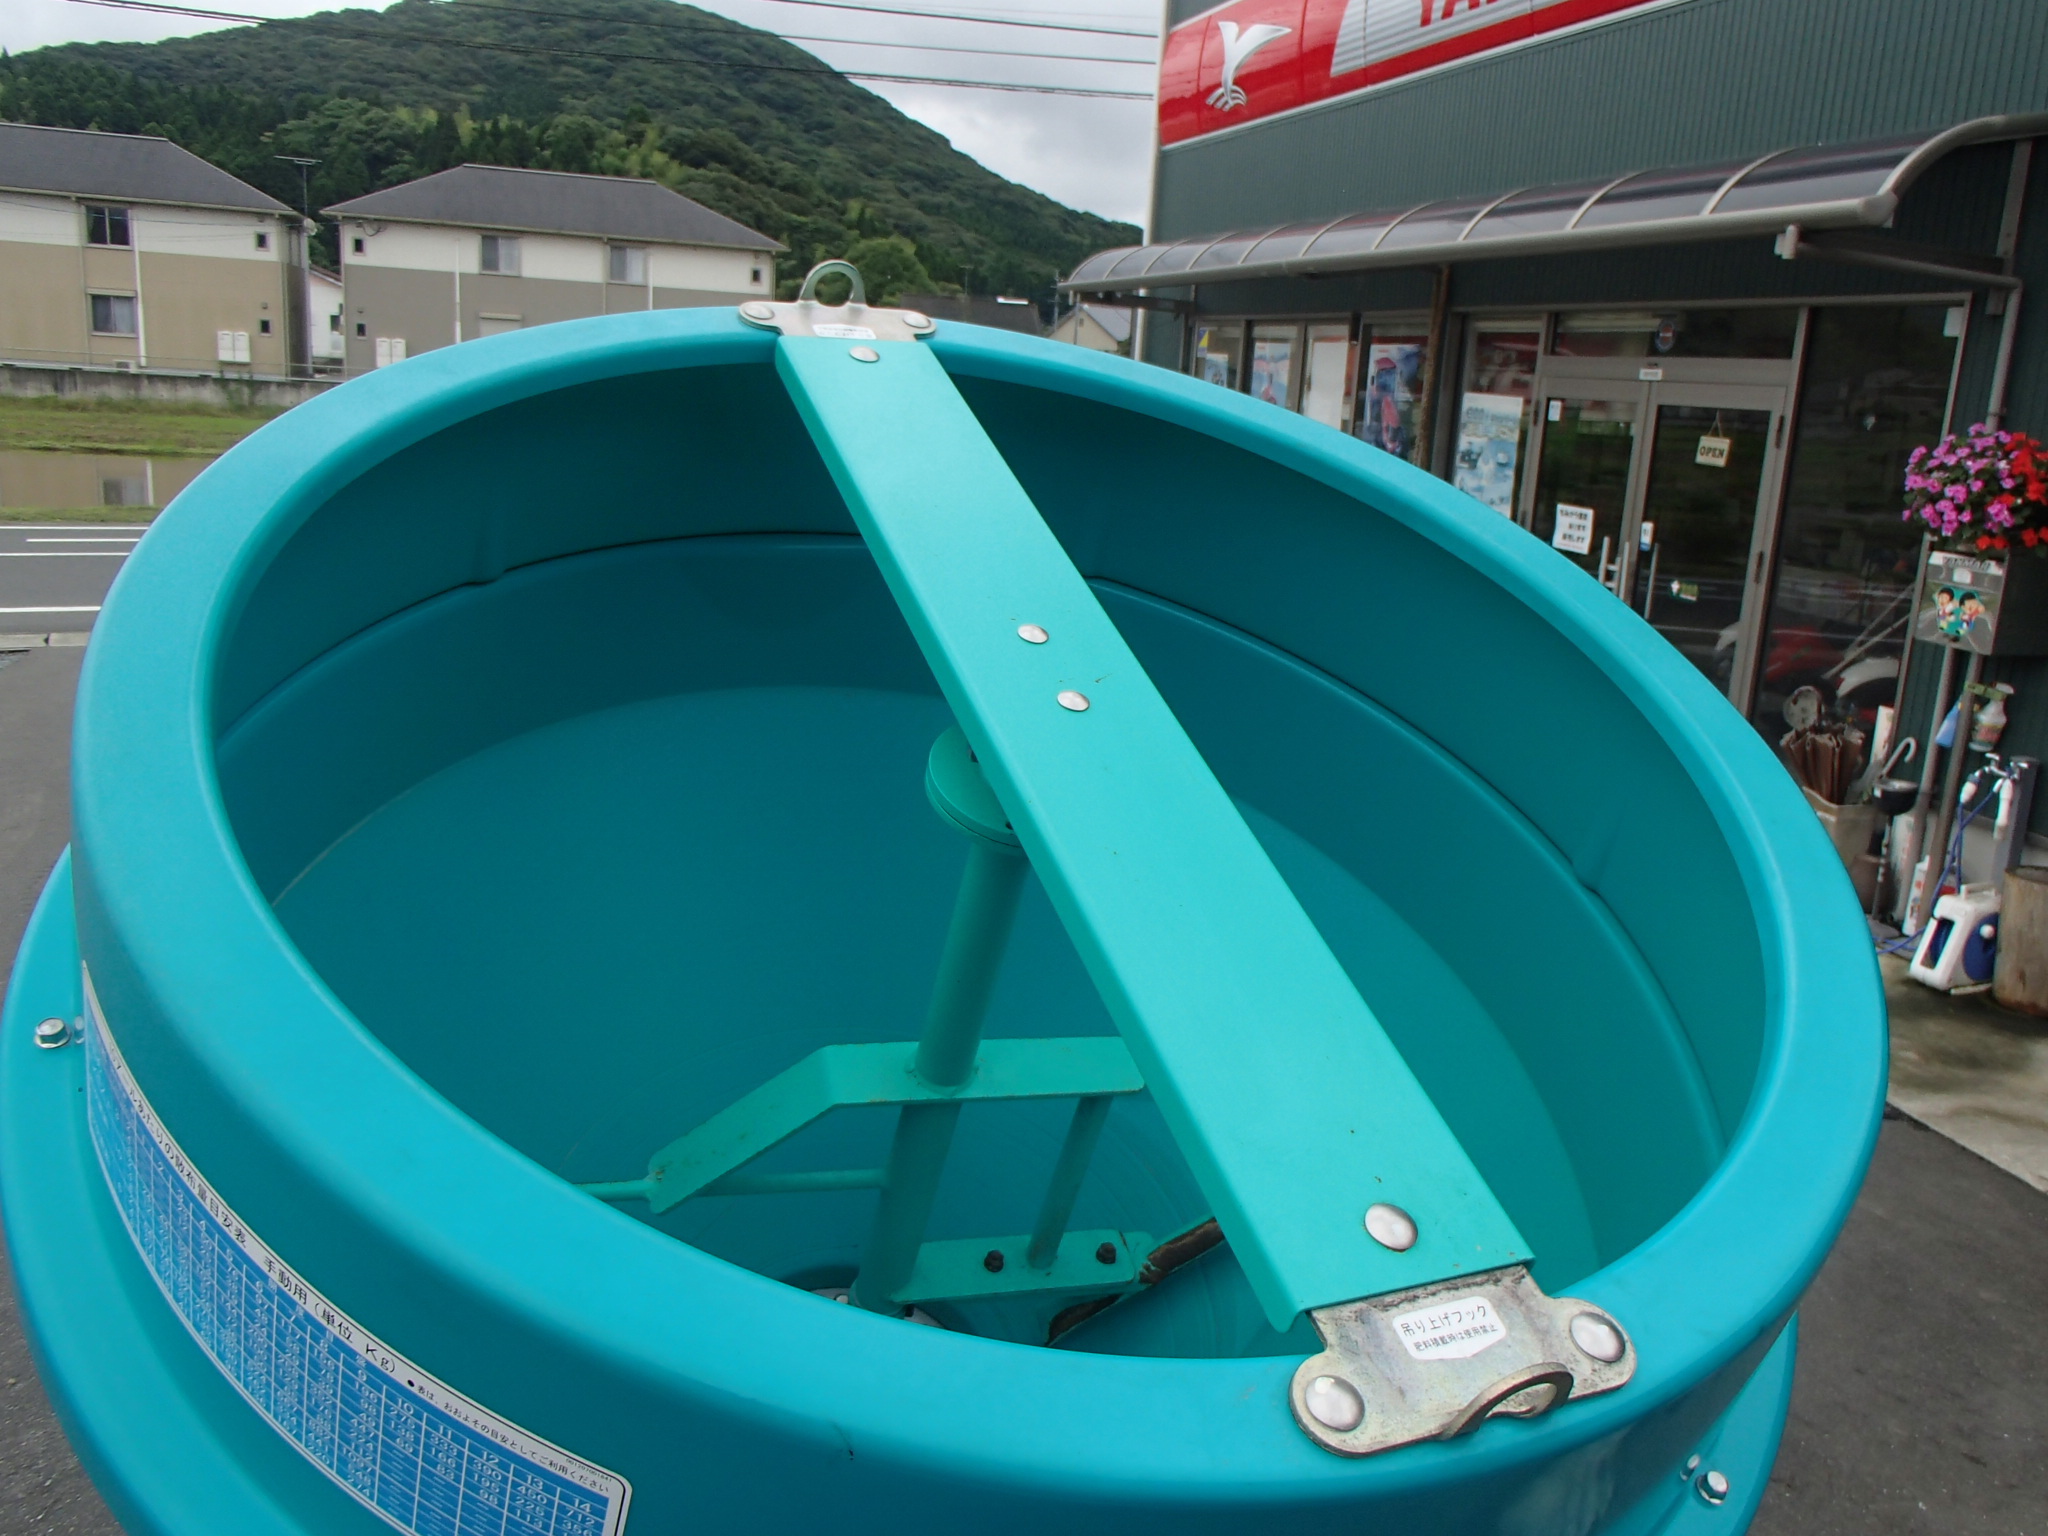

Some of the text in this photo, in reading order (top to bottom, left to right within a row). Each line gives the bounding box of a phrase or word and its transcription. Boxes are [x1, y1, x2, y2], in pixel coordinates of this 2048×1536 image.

[1700, 446, 1725, 458] OPEN
[1400, 1304, 1486, 1337] 吊り上げフック
[355, 1381, 378, 1403] 196
[390, 1407, 415, 1429] 275
[430, 1433, 457, 1456] 333
[473, 1460, 501, 1481] 390
[517, 1485, 547, 1505] 450
[566, 1506, 595, 1525] 712
[358, 1369, 367, 1381] 9
[397, 1398, 414, 1414] 10
[439, 1425, 452, 1439] 11
[482, 1451, 499, 1466] 12
[527, 1474, 543, 1490] 13
[574, 1498, 591, 1512] 14
[390, 1420, 414, 1441] 138
[432, 1447, 456, 1468] 166
[474, 1473, 500, 1492] 195
[516, 1496, 545, 1516] 225
[396, 1437, 413, 1453] 69
[437, 1463, 455, 1480] 83
[480, 1488, 498, 1505] 98
[516, 1509, 542, 1528] 113
